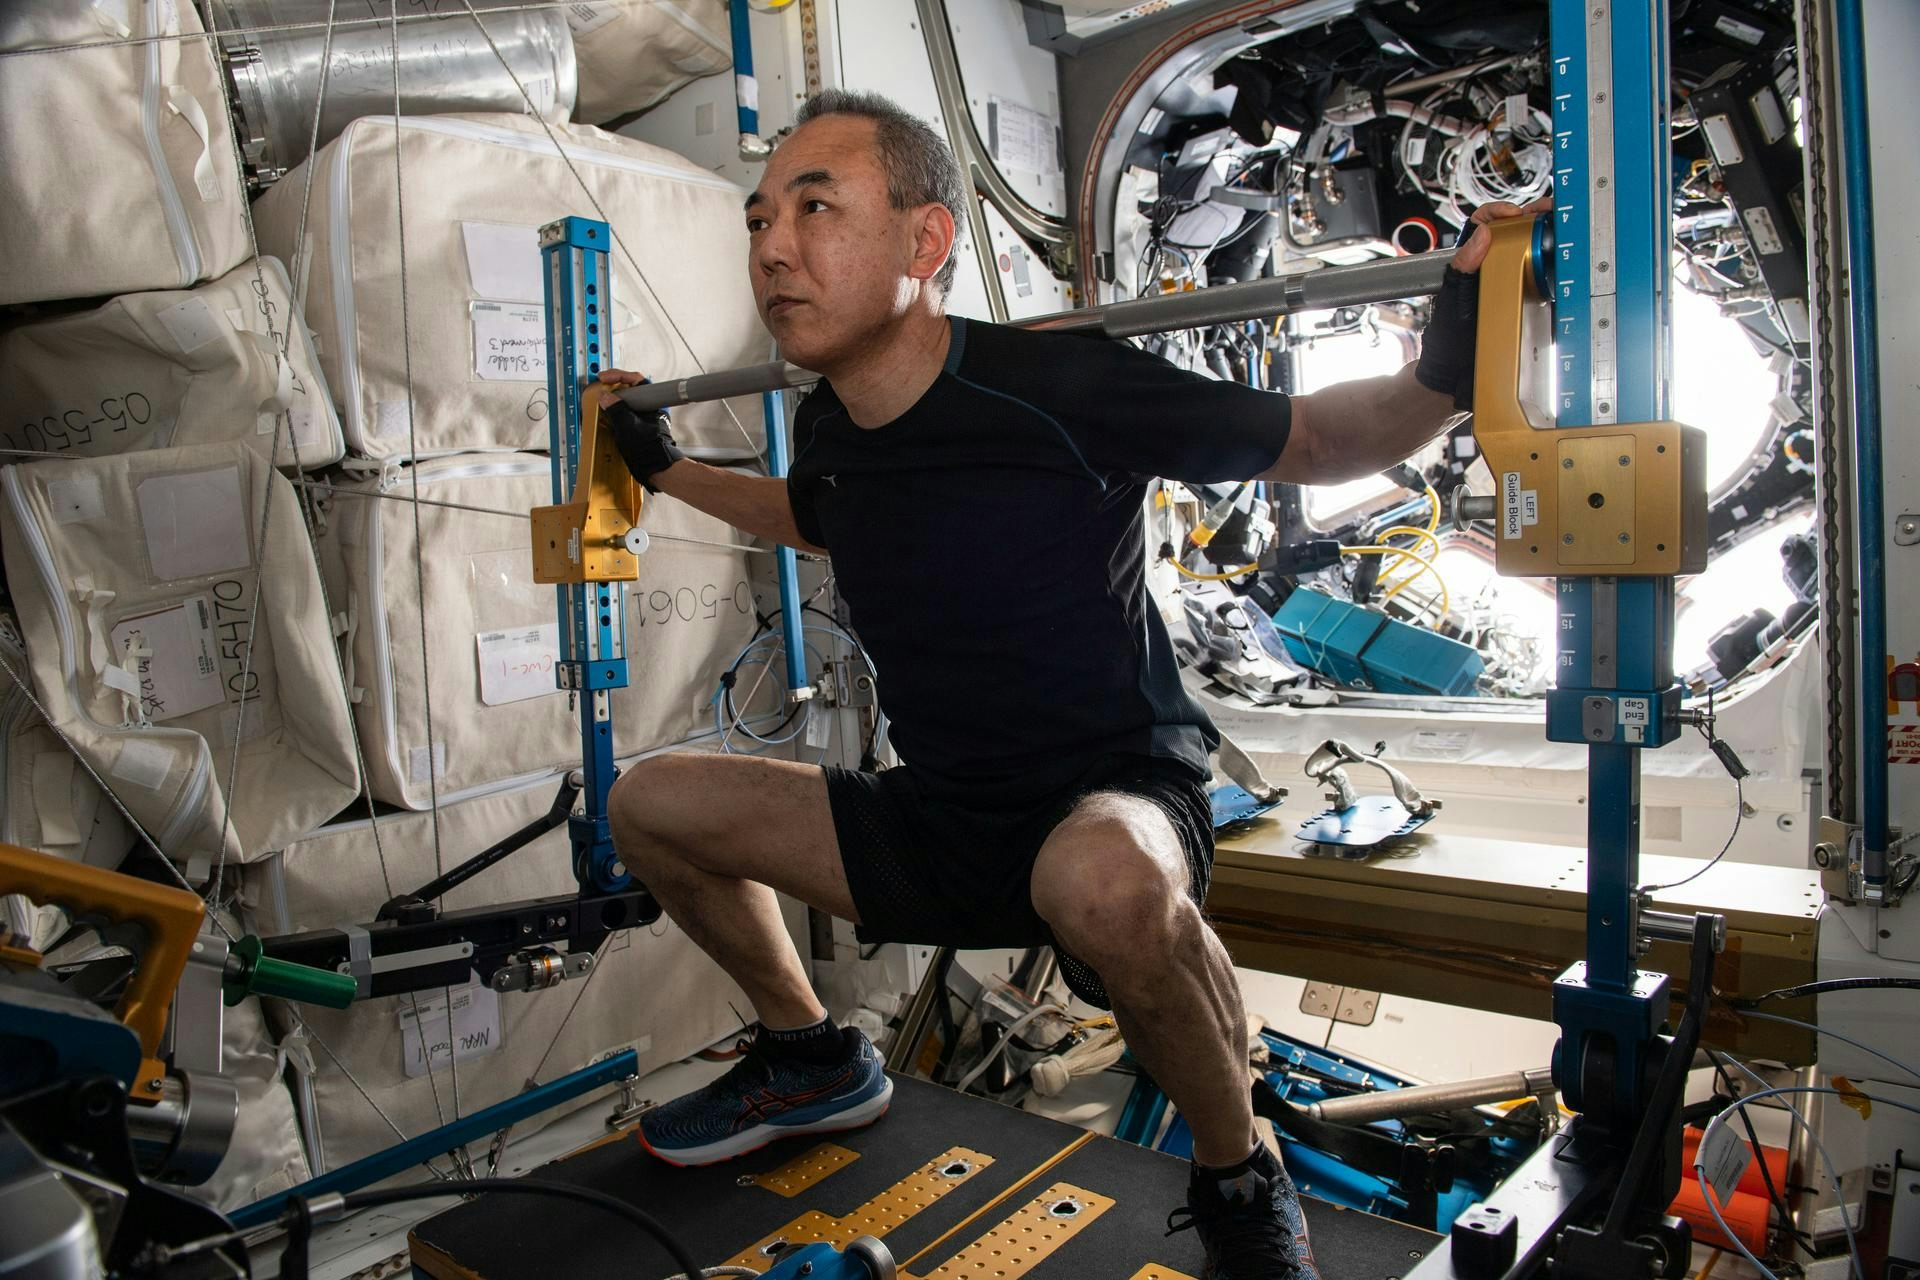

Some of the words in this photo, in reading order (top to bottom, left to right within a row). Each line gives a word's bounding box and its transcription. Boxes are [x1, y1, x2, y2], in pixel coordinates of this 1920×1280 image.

[1559, 63, 1566, 75] 0
[1560, 137, 1568, 149] 2
[1561, 174, 1568, 186] 3
[1561, 211, 1569, 224] 4
[1562, 248, 1569, 261] 5
[1562, 285, 1570, 298] 6
[1563, 323, 1570, 335] 7
[488, 337, 499, 351] 3
[499, 337, 547, 354] ontainment
[487, 355, 530, 373] Bladder
[1563, 359, 1570, 372] 8
[1563, 397, 1570, 409] 9
[1508, 473, 1518, 504] Guide
[1525, 496, 1535, 519] LEFT
[1508, 507, 1519, 535] Block
[1561, 583, 1574, 593] 14
[1561, 618, 1574, 630] 15
[1561, 655, 1574, 666] 16
[1624, 699, 1645, 710] Cap
[1624, 711, 1645, 721] End
[1632, 726, 1641, 741] L
